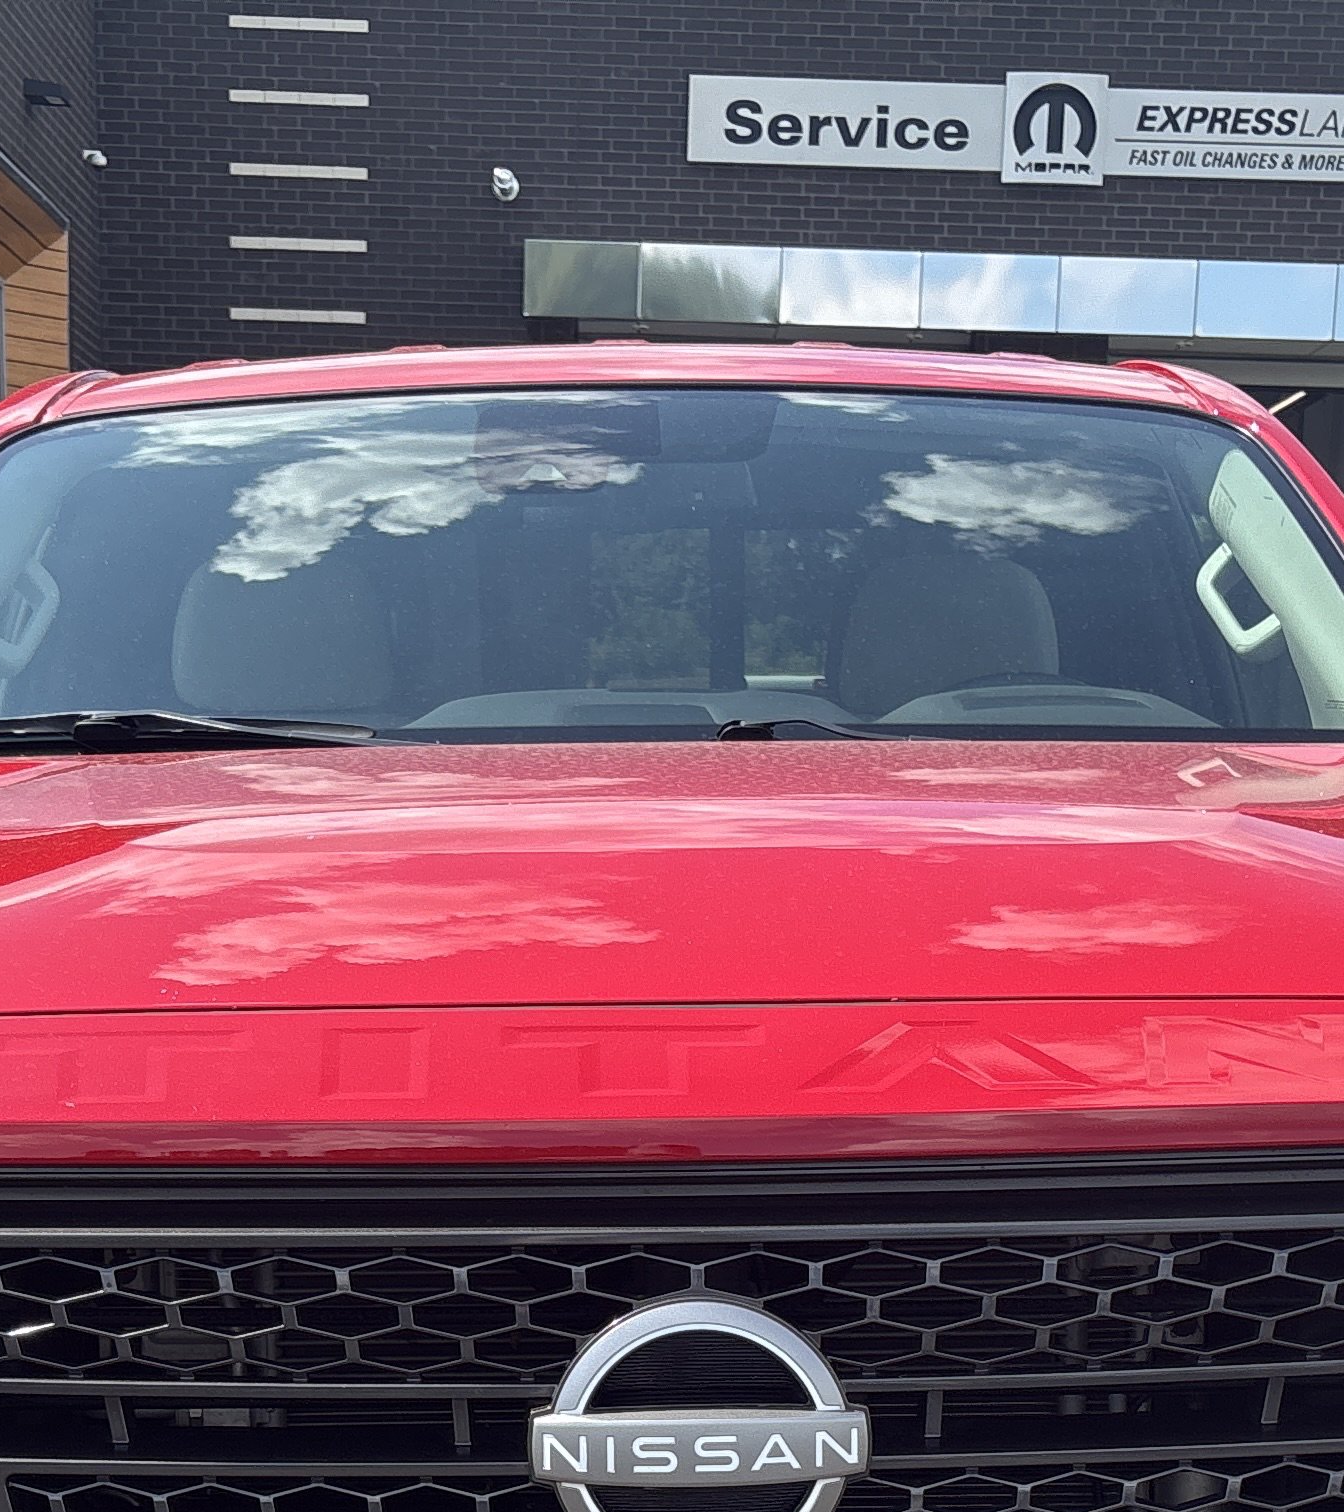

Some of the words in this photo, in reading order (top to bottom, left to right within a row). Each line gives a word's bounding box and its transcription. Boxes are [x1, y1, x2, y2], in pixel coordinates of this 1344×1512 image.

[723, 99, 971, 151] Service
[1014, 161, 1093, 175] MOPAR
[1128, 148, 1170, 167] FAST
[1172, 150, 1197, 167] OIL
[1200, 151, 1280, 170] CHANGES
[1280, 153, 1294, 170] &
[541, 1426, 859, 1474] NISSAN
